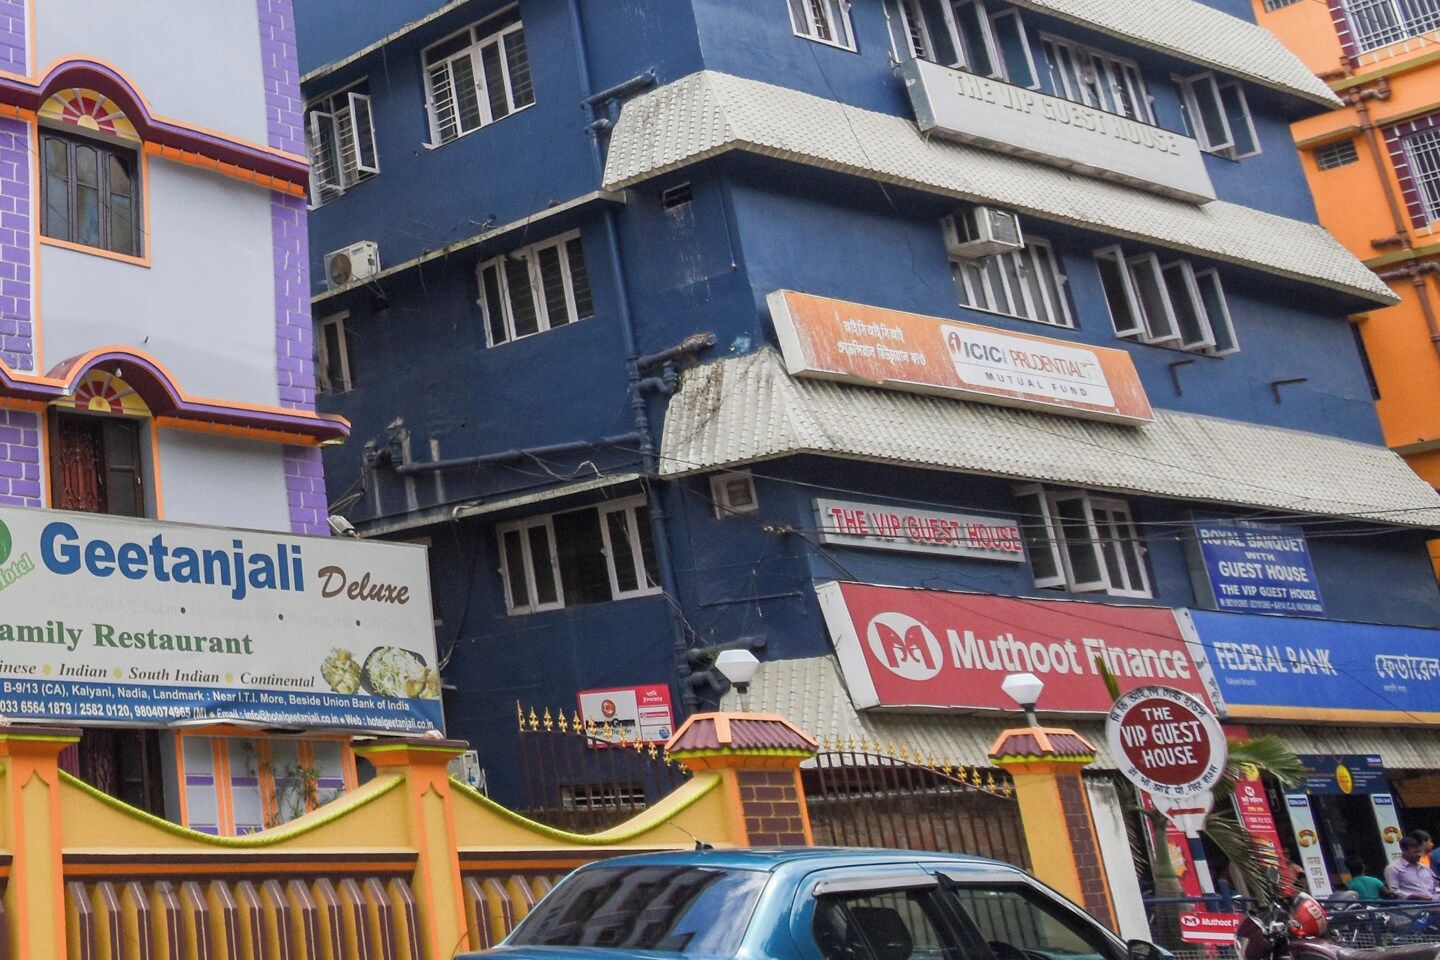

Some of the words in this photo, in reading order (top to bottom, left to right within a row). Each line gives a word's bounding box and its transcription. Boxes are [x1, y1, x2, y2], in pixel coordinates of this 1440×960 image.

[958, 76, 996, 105] THE
[1001, 85, 1034, 114] VIP
[1039, 97, 1107, 135] GUEST
[1109, 115, 1181, 157] HOUSE
[1009, 349, 1086, 379] PRUDENTIAL
[986, 372, 1044, 389] MUTUAL
[1052, 383, 1087, 397] FUND
[828, 507, 869, 536] THE
[871, 512, 901, 538] VIP
[907, 515, 961, 544] GUEST
[965, 523, 1022, 552] HOUSE
[1200, 529, 1245, 547] ROYAL
[1246, 532, 1304, 552] BANQUET
[40, 521, 304, 601] Geetanjali
[318, 565, 409, 605] Deluxe
[1245, 552, 1275, 561] WITH
[1219, 561, 1263, 579] GUEST
[1265, 565, 1309, 582] HOUSE
[1219, 584, 1240, 595] THE
[1242, 585, 1257, 596] VIP
[1260, 587, 1287, 598] GUEST
[1290, 589, 1317, 600] HOUSE
[91, 623, 254, 655] Restaurant
[946, 629, 1083, 675] Muthoot
[1082, 638, 1191, 680] Finance
[1213, 642, 1288, 673] FEDERAL
[1285, 646, 1338, 676] BANK
[59, 663, 108, 679] Indian
[128, 666, 170, 682] South
[175, 667, 219, 683] Indian
[240, 672, 315, 688] Continental
[3, 681, 39, 694] B-9/13
[41, 683, 69, 697] (CA),
[71, 684, 115, 699] Kalyani,
[117, 686, 151, 700] Nadia,
[153, 688, 204, 701] Landmark
[212, 691, 236, 702] Near
[238, 692, 258, 703] I.T.I.
[260, 693, 287, 706] More,
[289, 694, 320, 706] Beside
[323, 696, 350, 708] Union
[352, 698, 375, 709] Bank
[377, 700, 386, 710] of
[387, 700, 410, 711] India
[0, 700, 18, 713] 033
[20, 701, 46, 714] 6564
[48, 702, 72, 715] 1879
[80, 703, 104, 716] 2582
[106, 704, 133, 719] 0120,
[344, 714, 362, 726] Web
[367, 714, 434, 731] hotelgeetanjali.co.in
[1141, 707, 1173, 721] THE
[1121, 725, 1147, 747] VIP
[1152, 721, 1202, 745] GUEST
[1141, 745, 1198, 768] HOUSE
[1201, 918, 1231, 926] Muthoot
